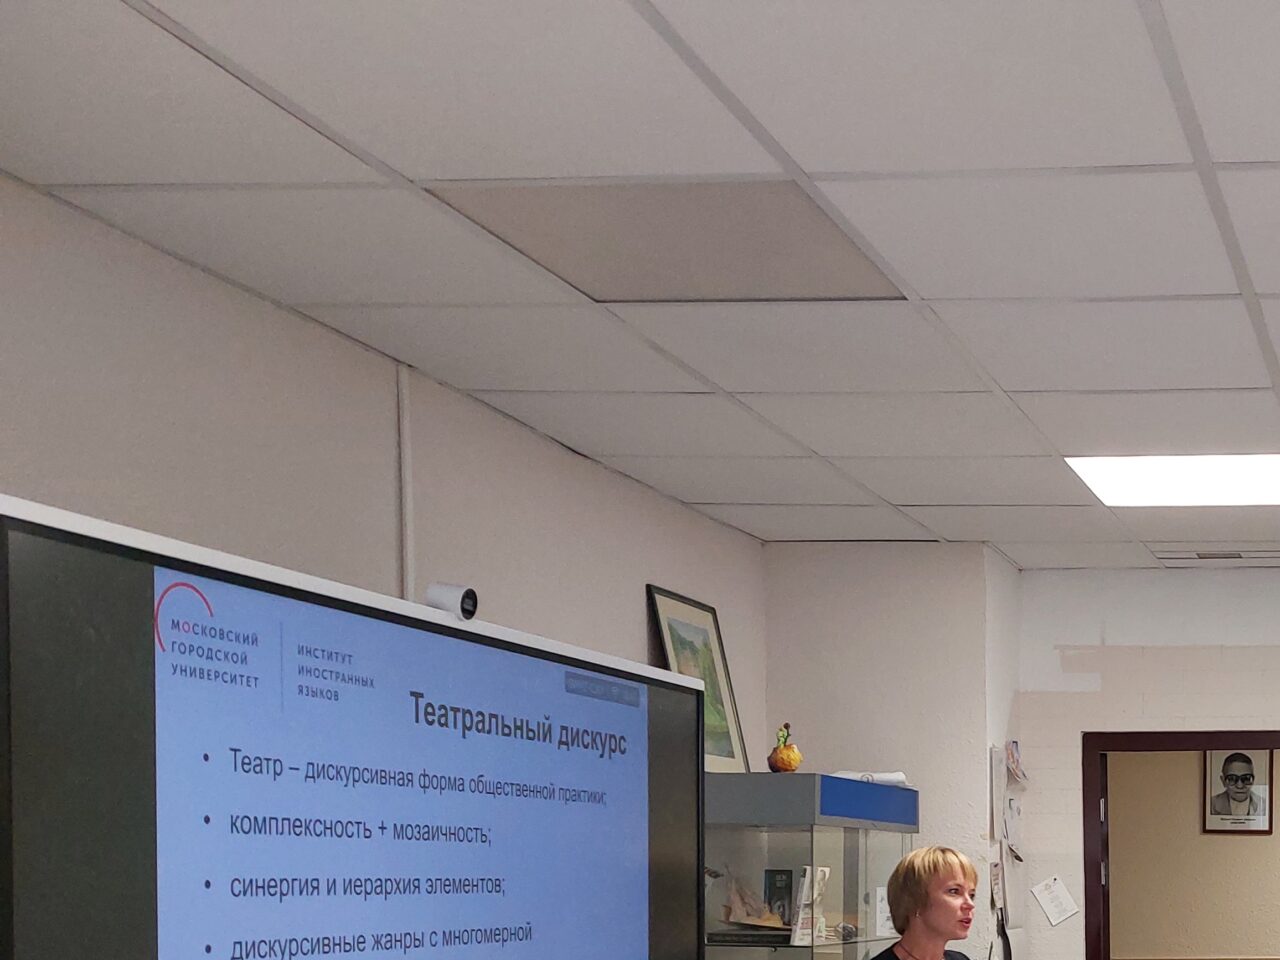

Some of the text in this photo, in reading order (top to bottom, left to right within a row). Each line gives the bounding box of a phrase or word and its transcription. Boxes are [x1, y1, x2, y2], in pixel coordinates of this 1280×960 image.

[171, 618, 259, 648] МОСКОВСКИЙ
[171, 641, 249, 666] ГОРОДСКОЙ
[297, 644, 354, 665] ИНСТИТУТ
[171, 663, 259, 688] УНИВЕРСИТЕТ
[297, 664, 375, 689] ИНОСТРАННЫХ
[297, 684, 340, 702] ЯЗЫКОВ
[409, 690, 628, 760] Театральный дискурс
[228, 747, 284, 782] Театр
[304, 761, 414, 788] дискурсивная
[418, 768, 465, 795] форма
[469, 775, 556, 801] общественной
[558, 787, 608, 806] практики;
[229, 814, 373, 840] комплексность
[393, 822, 492, 847] мозаичность;
[229, 876, 506, 904] синергия и иерархия элементов;
[371, 930, 425, 955] жанры
[428, 930, 438, 948] с
[442, 921, 533, 949] многомерной
